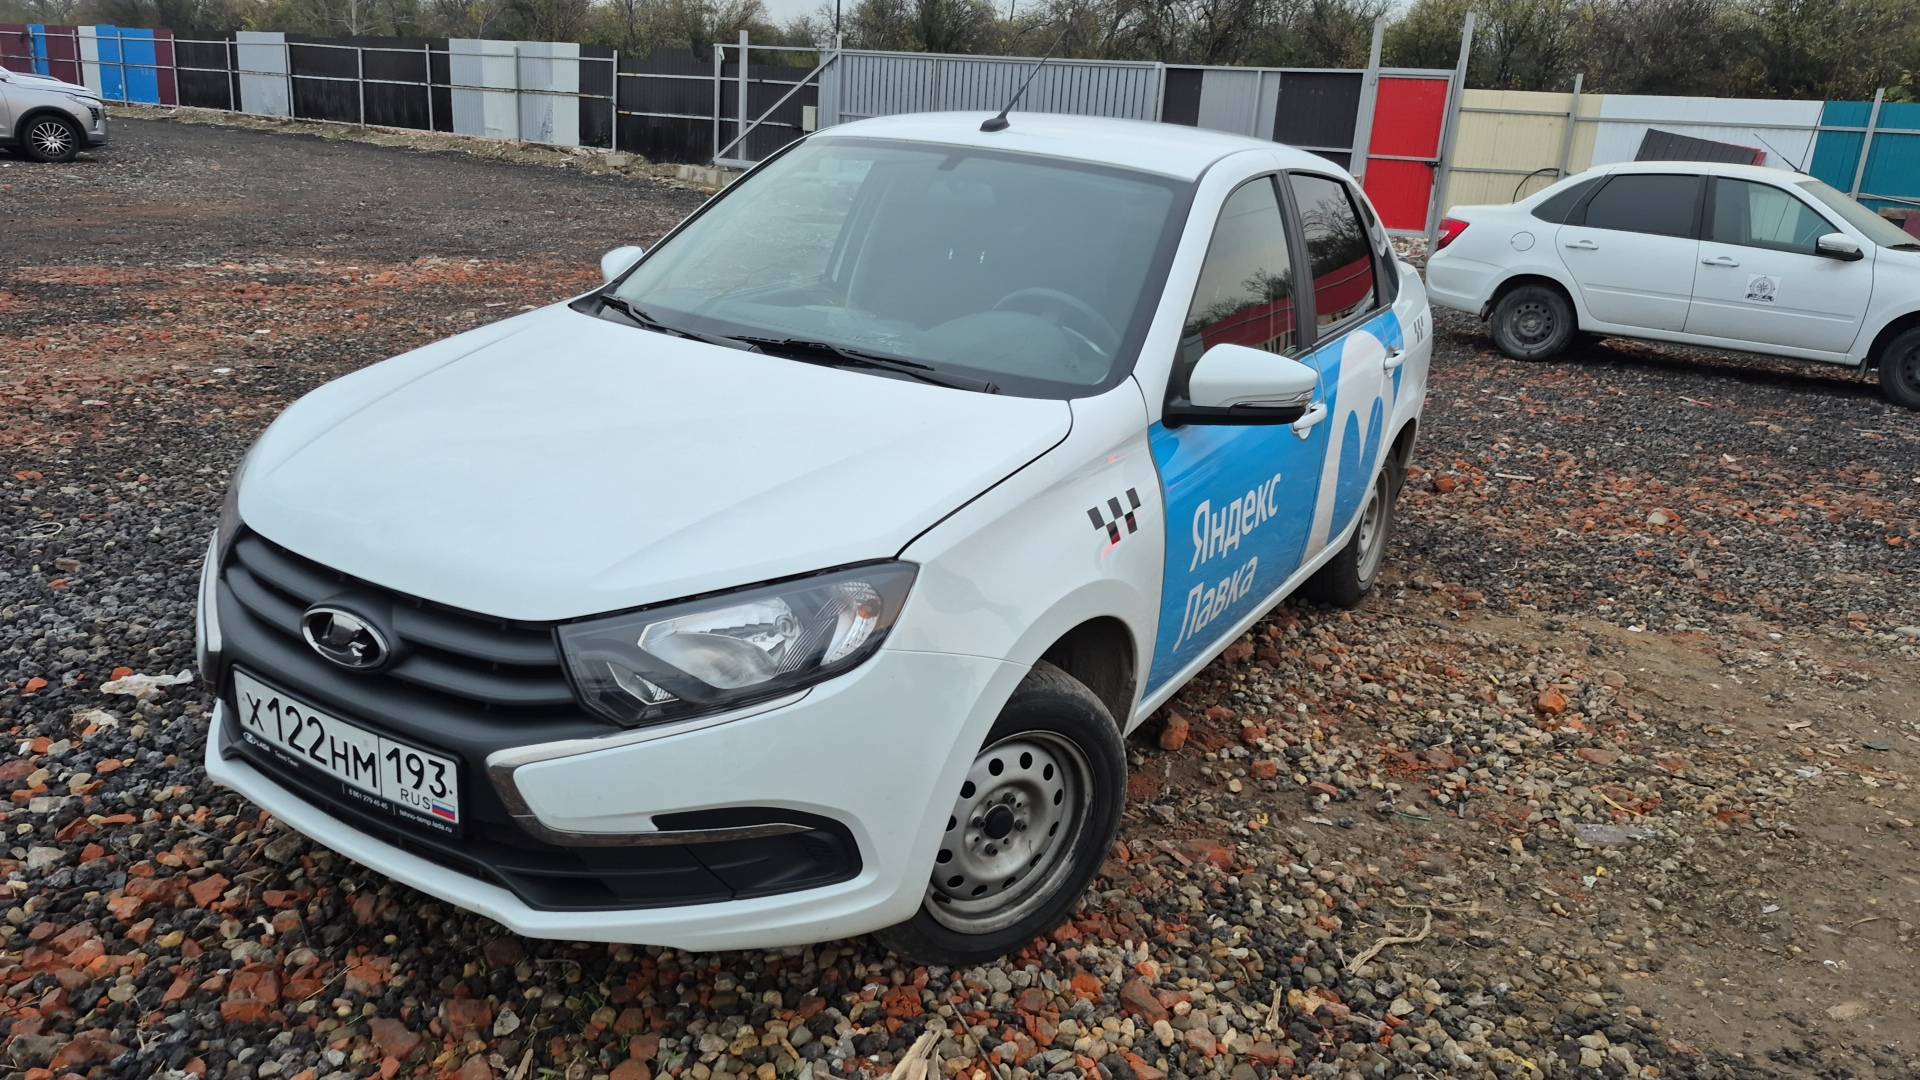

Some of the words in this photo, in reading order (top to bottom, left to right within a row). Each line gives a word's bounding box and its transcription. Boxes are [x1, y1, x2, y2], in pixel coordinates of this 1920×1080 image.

[1189, 472, 1282, 572] Яндекс
[1173, 556, 1258, 652] Лавка
[385, 747, 447, 798] 193
[400, 788, 430, 809] RUS
